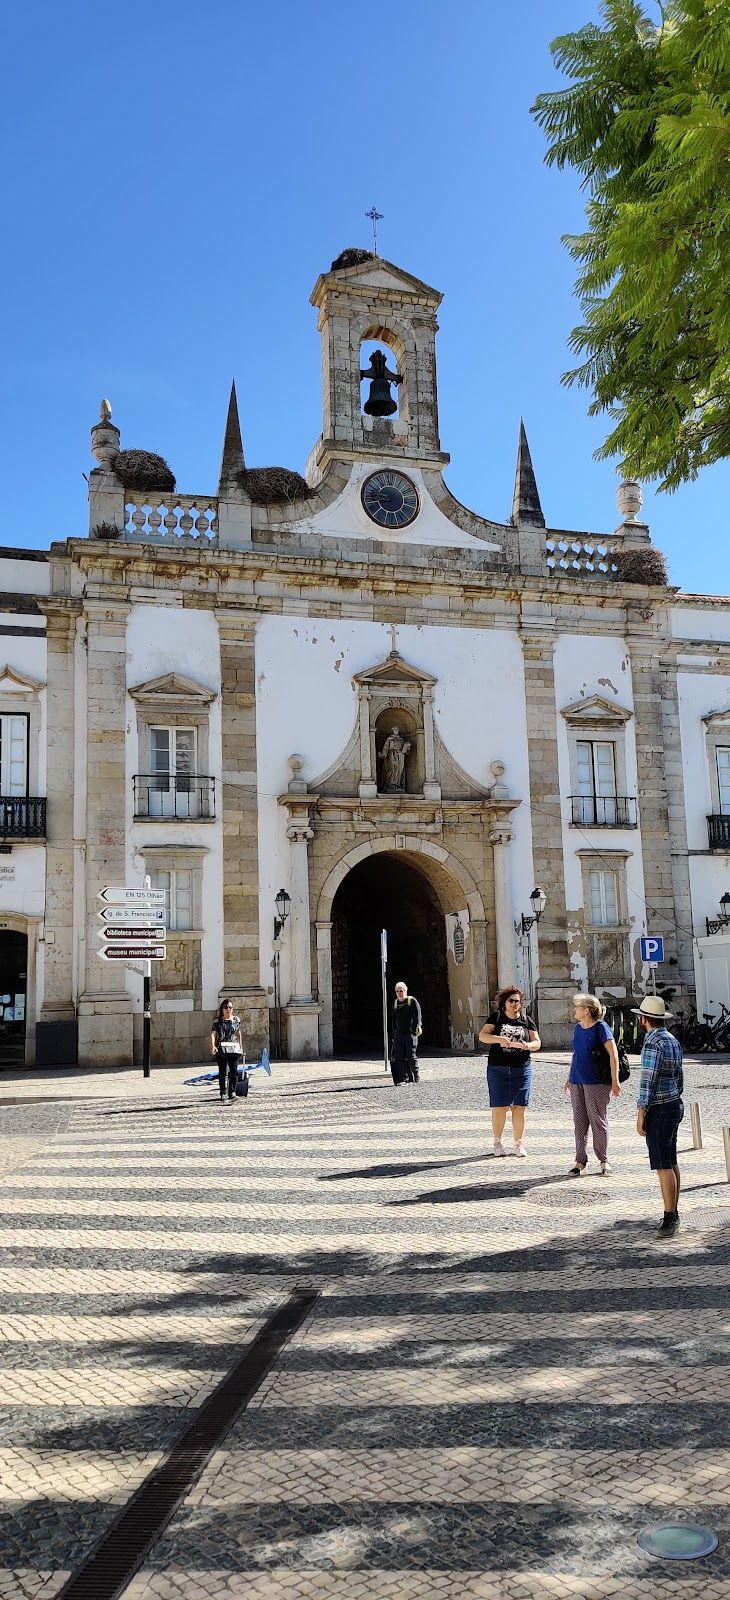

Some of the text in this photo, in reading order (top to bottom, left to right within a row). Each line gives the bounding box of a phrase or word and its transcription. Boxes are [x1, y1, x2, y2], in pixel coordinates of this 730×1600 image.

[132, 929, 156, 938] municipal
[128, 949, 157, 957] municipal
[644, 939, 659, 960] P
